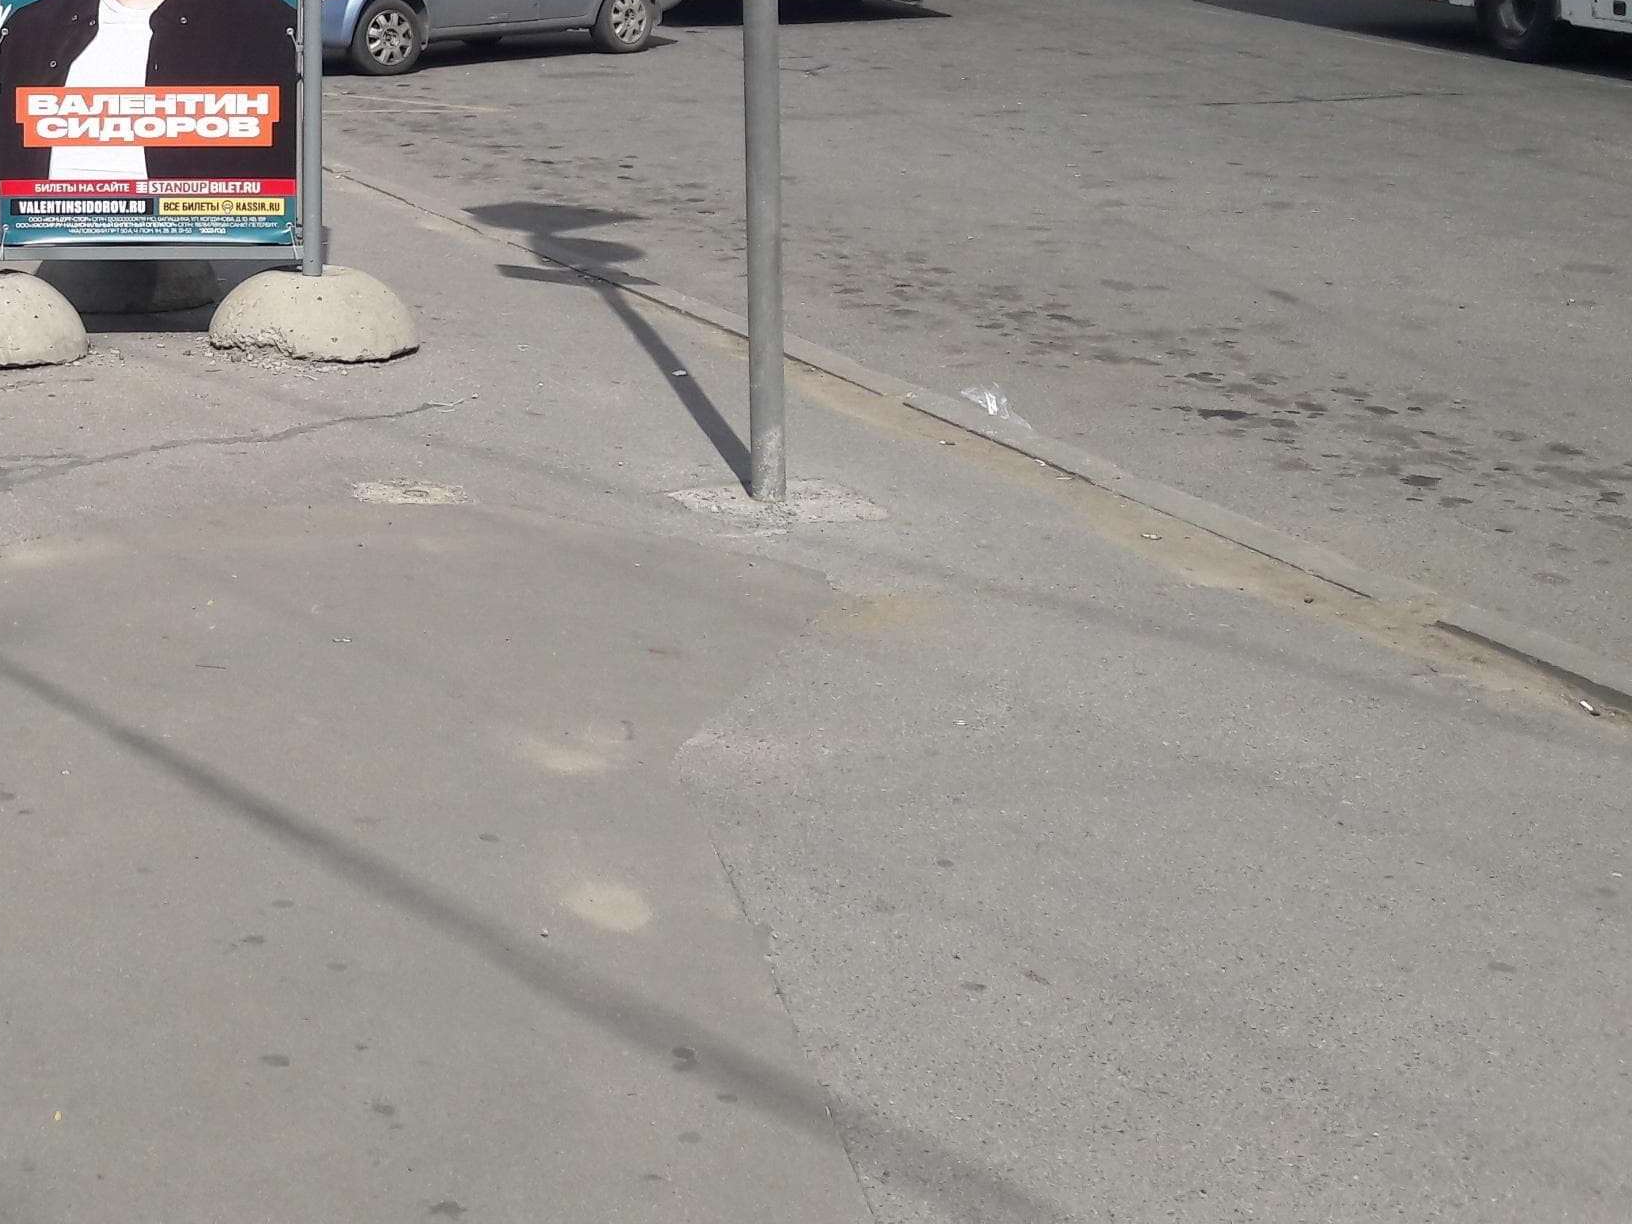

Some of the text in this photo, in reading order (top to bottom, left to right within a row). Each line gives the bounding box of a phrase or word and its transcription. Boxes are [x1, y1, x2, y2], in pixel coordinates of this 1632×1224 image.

[27, 93, 269, 116] ВАЛЕНТИН
[36, 116, 260, 142] СИДОРОВ
[35, 183, 76, 193] БИЛЕТЫ
[78, 183, 95, 192] НА
[96, 181, 130, 193] САЙТЕ
[18, 200, 146, 214] VALENTINSIDOROV.RU
[163, 202, 280, 212] ВСЕ БИЛЕТЫ KASSIR.RU
